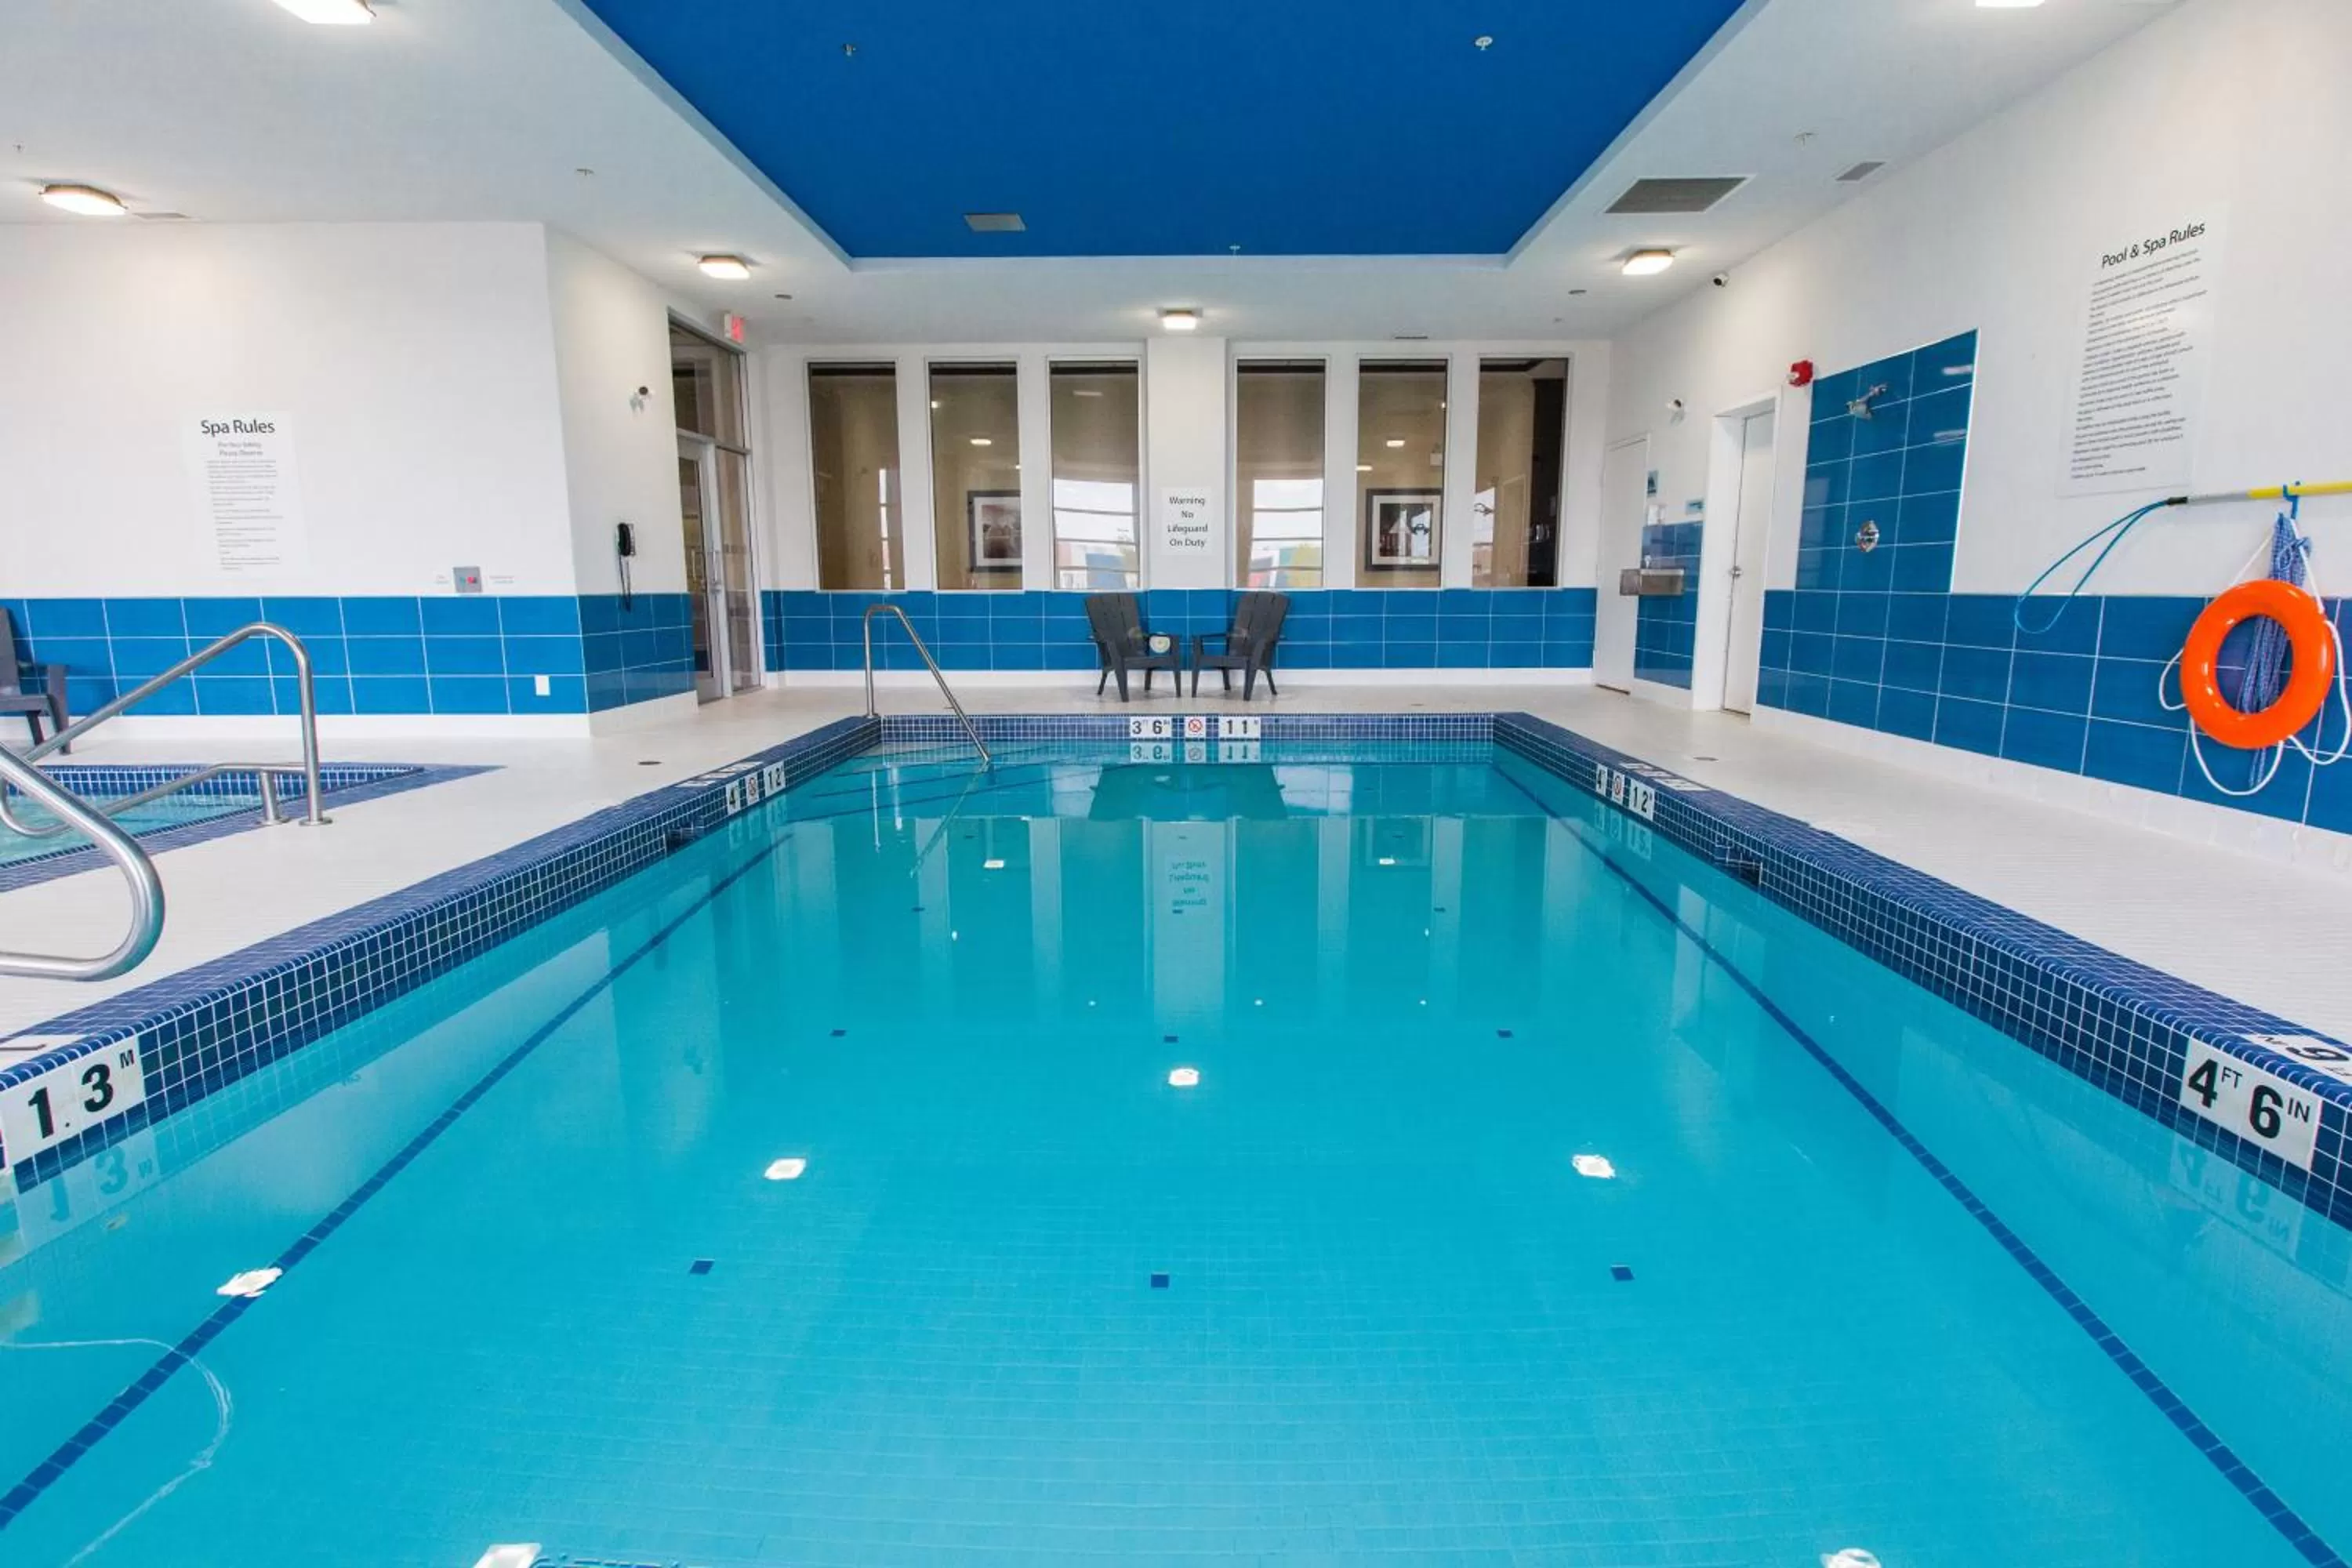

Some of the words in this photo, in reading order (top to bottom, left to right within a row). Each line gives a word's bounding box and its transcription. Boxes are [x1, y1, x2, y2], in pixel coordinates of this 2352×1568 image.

[2102, 248, 2127, 268] Pool
[2130, 245, 2139, 258] &
[2143, 239, 2166, 256] Spa
[2169, 223, 2205, 245] Rules
[201, 419, 230, 437] Spa
[233, 418, 275, 433] Rules
[1169, 497, 1205, 506] Warning
[1185, 538, 1205, 548] Duty
[120, 1049, 135, 1069] M
[2188, 1058, 2218, 1108] 4
[2221, 1066, 2242, 1089] FT
[2249, 1084, 2283, 1139] 6
[2287, 1099, 2310, 1123] IN
